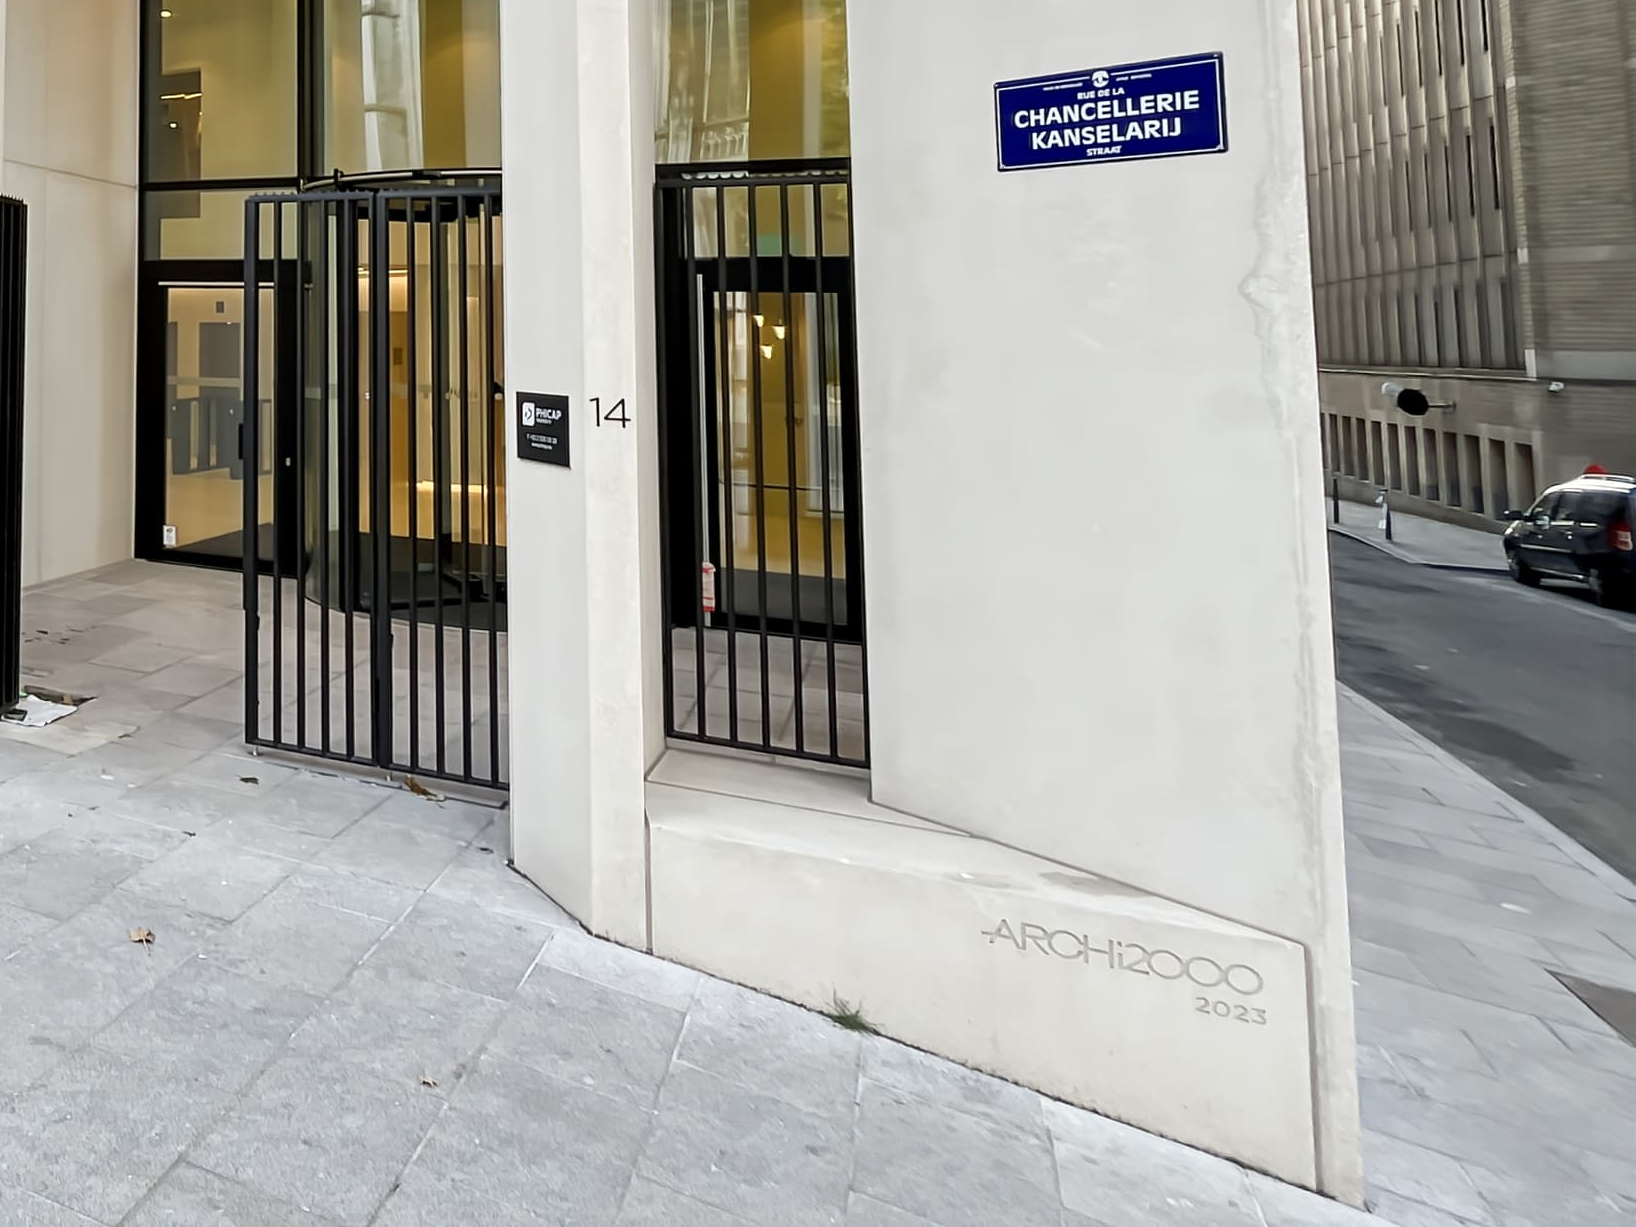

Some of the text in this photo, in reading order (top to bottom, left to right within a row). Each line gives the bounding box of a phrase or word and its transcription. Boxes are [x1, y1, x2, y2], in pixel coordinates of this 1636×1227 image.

[1077, 87, 1125, 100] RUE DE LA
[1014, 90, 1200, 128] CHANCELLERIE
[1032, 117, 1181, 150] KANSELARIJ
[1086, 145, 1122, 156] STRAAT
[589, 397, 631, 428] 14
[1196, 996, 1268, 1025] 2023
